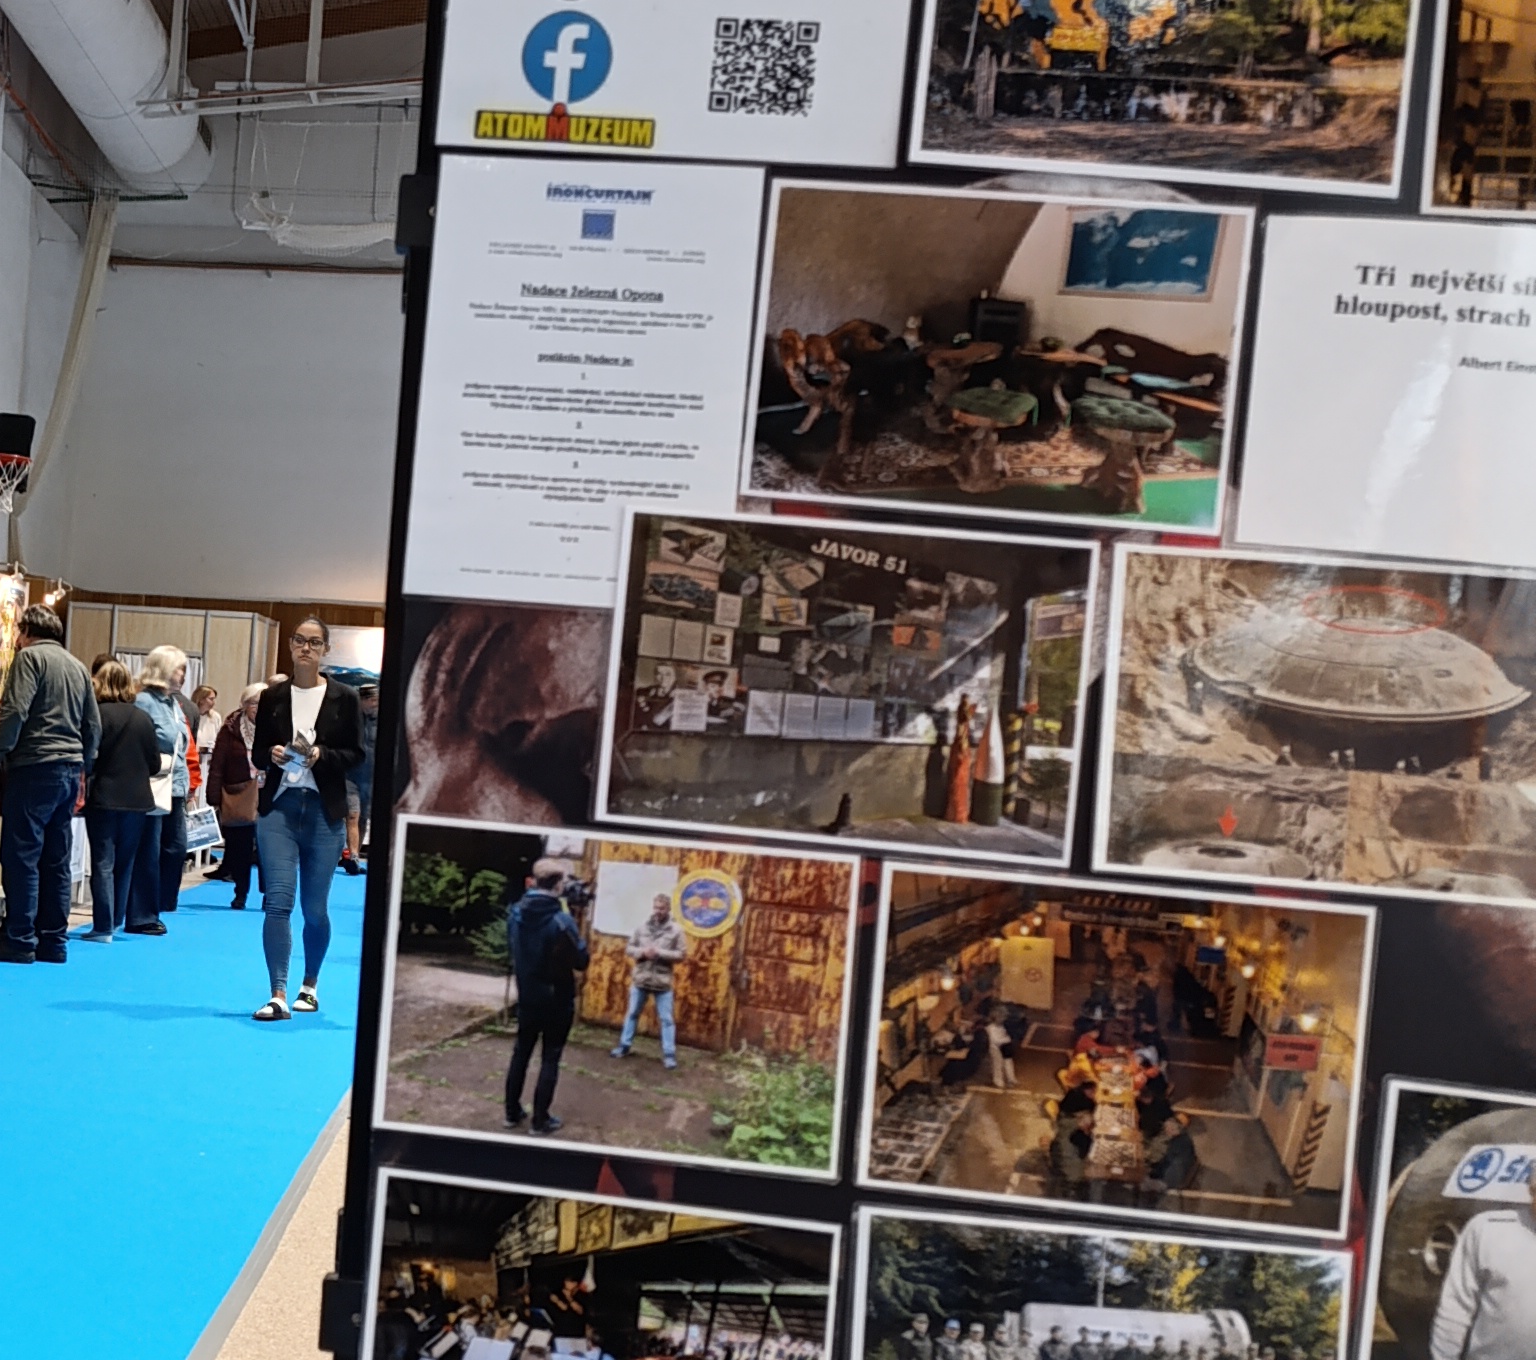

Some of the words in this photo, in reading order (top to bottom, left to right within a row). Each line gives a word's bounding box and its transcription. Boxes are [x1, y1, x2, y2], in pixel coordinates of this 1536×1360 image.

[476, 110, 655, 147] ATOMMUZEUM
[521, 282, 568, 299] Nadace
[622, 288, 664, 302] Opona
[1356, 264, 1397, 287] Tři
[1410, 269, 1505, 296] největší
[1334, 294, 1449, 325] hloupost,
[1456, 305, 1531, 328] strach
[1458, 356, 1502, 372] Albert
[810, 538, 880, 568] JAVOR
[884, 555, 907, 575] 51
